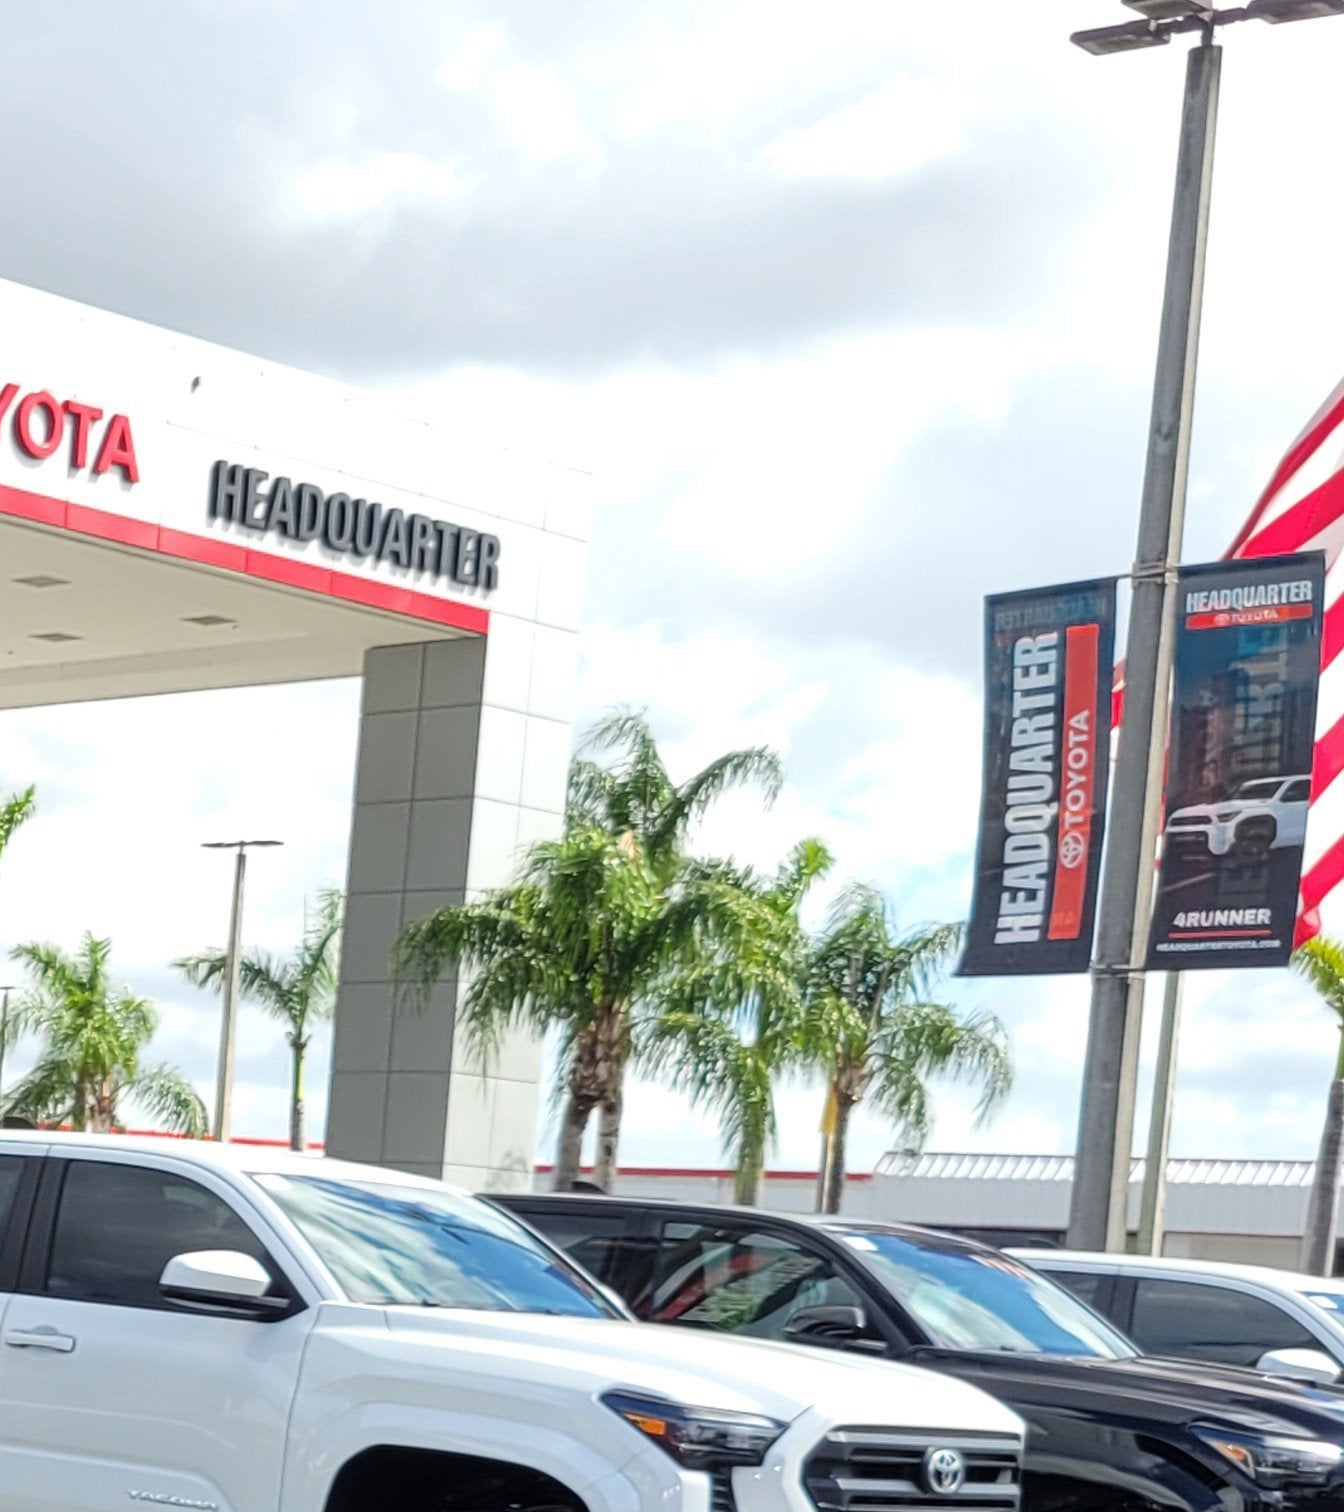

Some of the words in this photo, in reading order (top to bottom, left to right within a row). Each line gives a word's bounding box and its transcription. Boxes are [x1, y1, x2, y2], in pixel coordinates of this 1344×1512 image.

[208, 459, 501, 589] HEADQUARTER
[1186, 580, 1313, 614] HEADQUARTER
[1232, 609, 1279, 623] TOYOTA
[994, 631, 1058, 945] HEADQUARTER
[1062, 709, 1091, 828] TOYOTA
[1172, 908, 1272, 928] 4RUNNER
